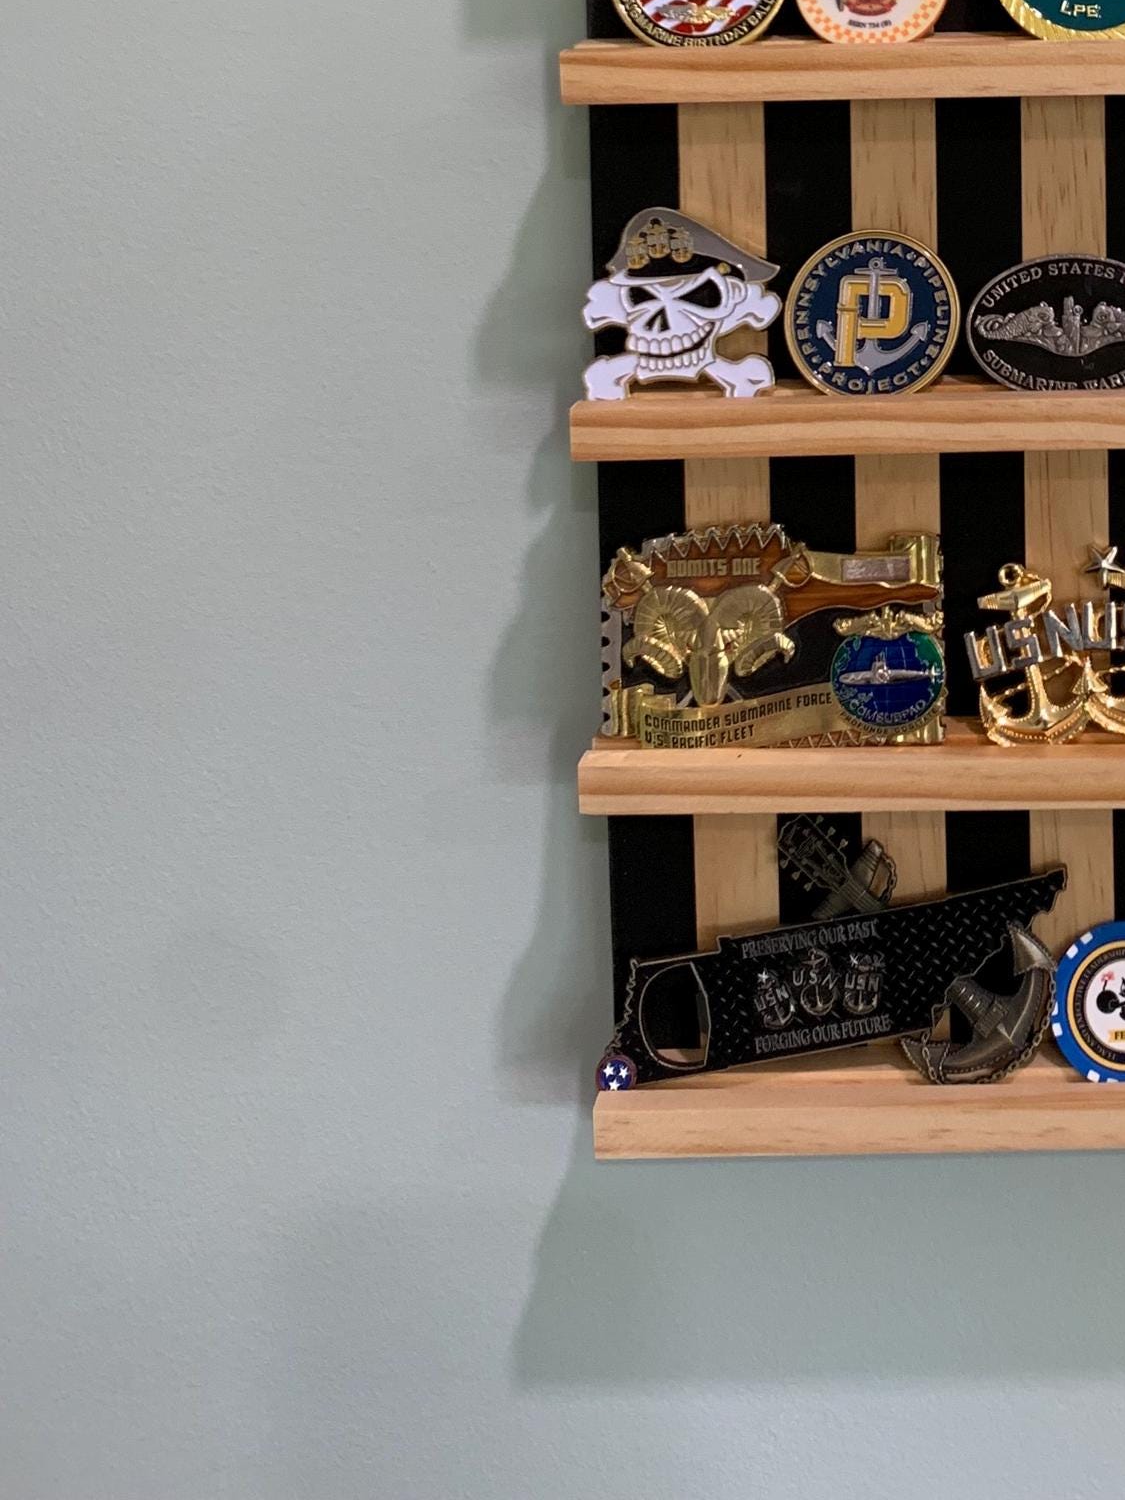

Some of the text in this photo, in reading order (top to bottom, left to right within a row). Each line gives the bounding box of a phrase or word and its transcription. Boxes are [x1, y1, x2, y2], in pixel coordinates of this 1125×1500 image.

[1059, 0, 1102, 19] LPE
[683, 19, 750, 47] BIRTHDAY
[981, 266, 1043, 308] UNITED
[1048, 262, 1116, 279] STATES
[796, 240, 950, 394] PENNSYLVANIA PIPELINE PROJECT
[982, 349, 1079, 390] SUBMARINE
[964, 602, 1084, 682] USN
[644, 692, 833, 734] COMMANDER SUBMARINE FORCE
[671, 733, 717, 748] PACIFIC
[720, 725, 755, 745] FLEET
[741, 919, 879, 960] PRESERVING OUR PAST
[754, 1014, 892, 1054] FORGING OUR FUTURE
